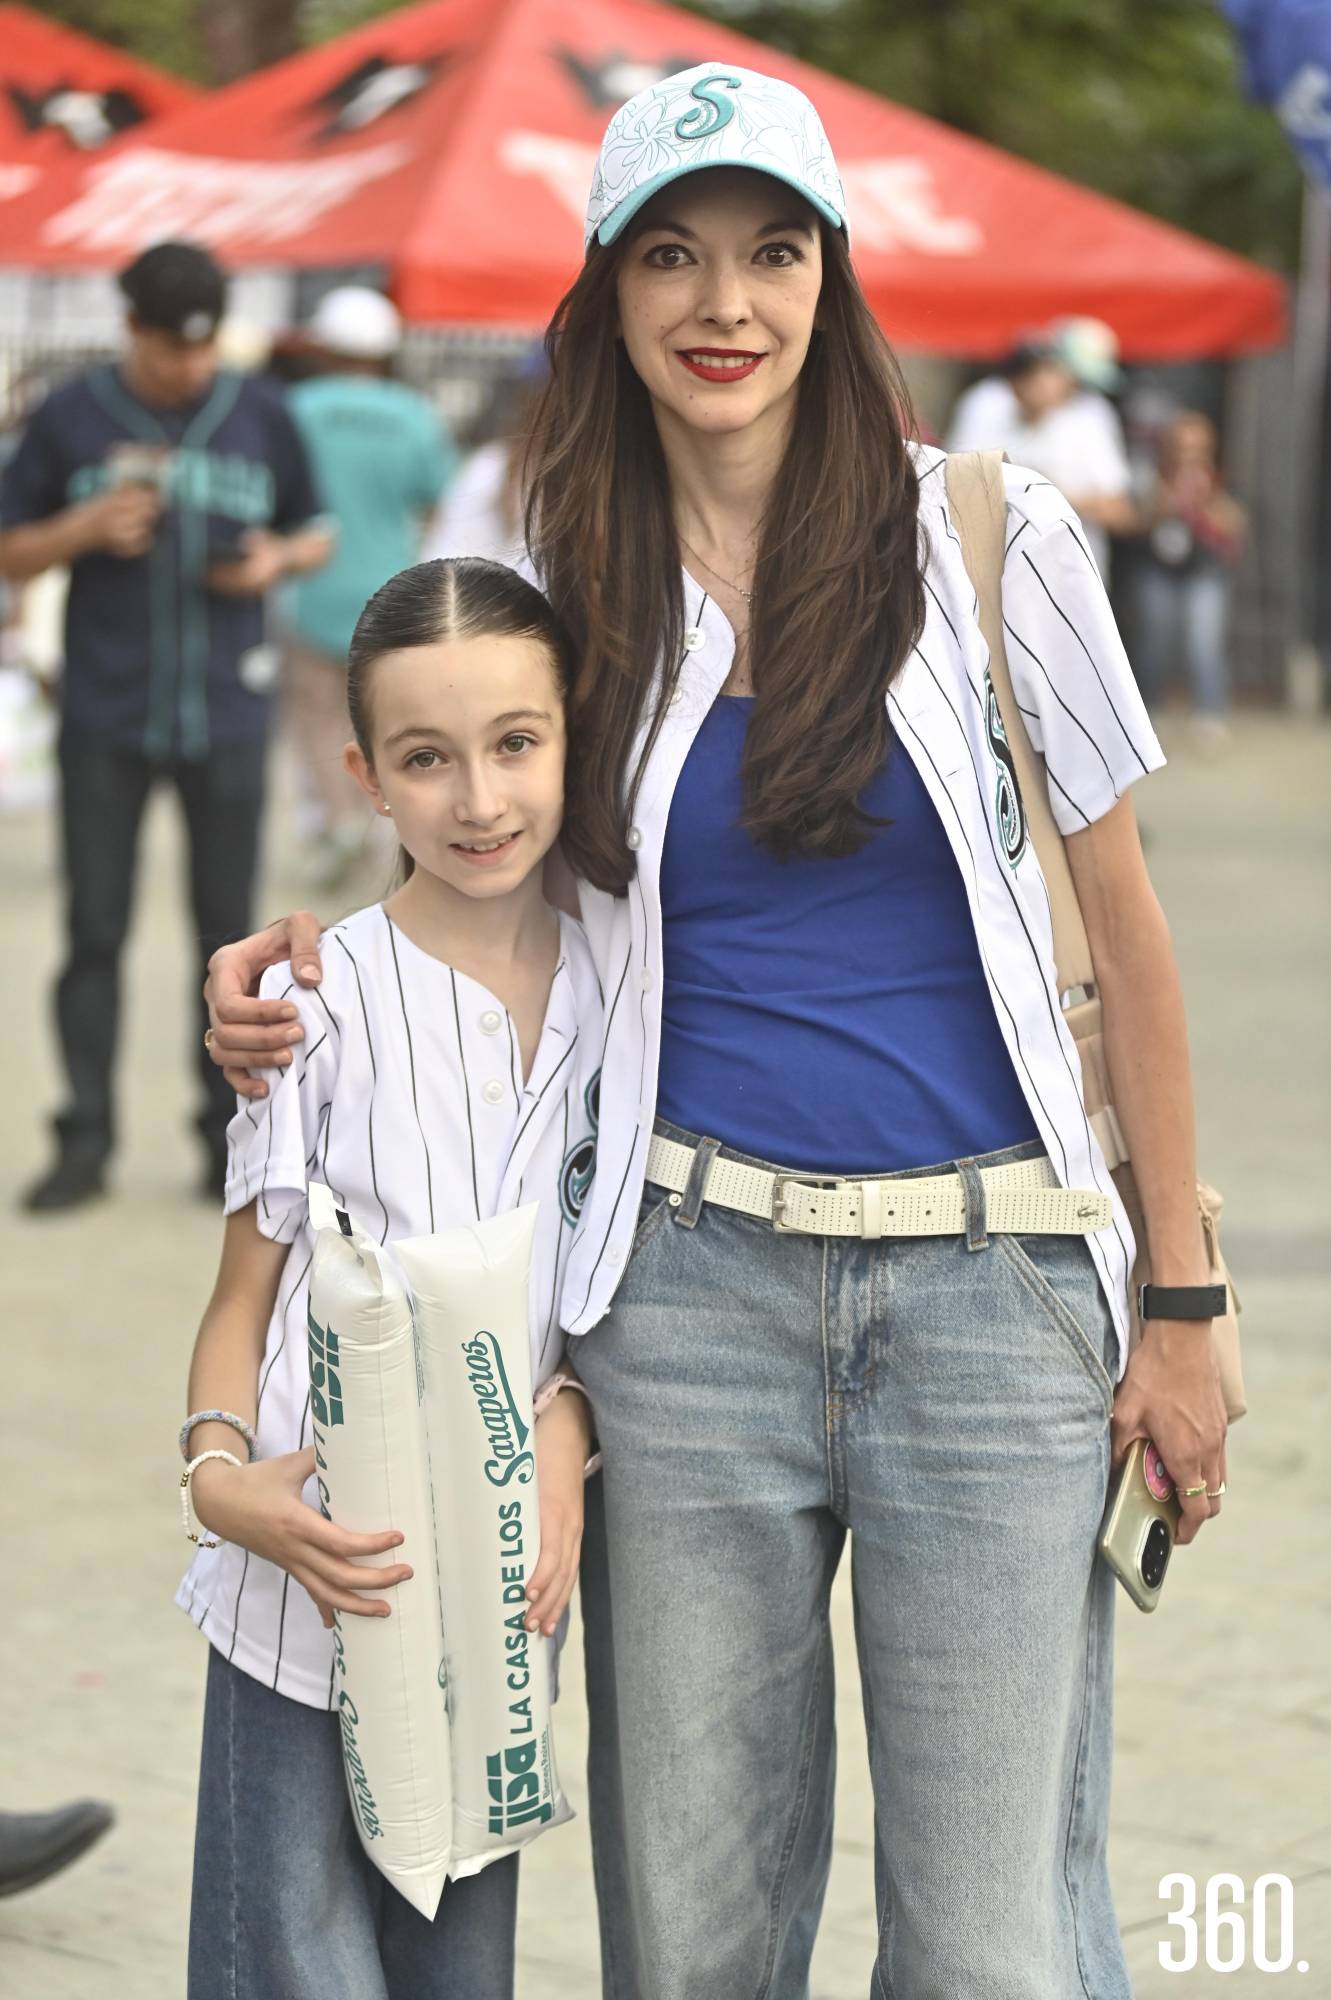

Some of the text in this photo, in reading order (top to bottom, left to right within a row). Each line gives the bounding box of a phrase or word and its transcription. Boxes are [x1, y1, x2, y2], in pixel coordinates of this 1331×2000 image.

[675, 75, 741, 139] S
[461, 1331, 534, 1487] Saraperos
[498, 1501, 523, 1557] LOS
[501, 1564, 526, 1604] DE
[504, 1610, 530, 1690] CASA
[509, 1696, 532, 1734] LA
